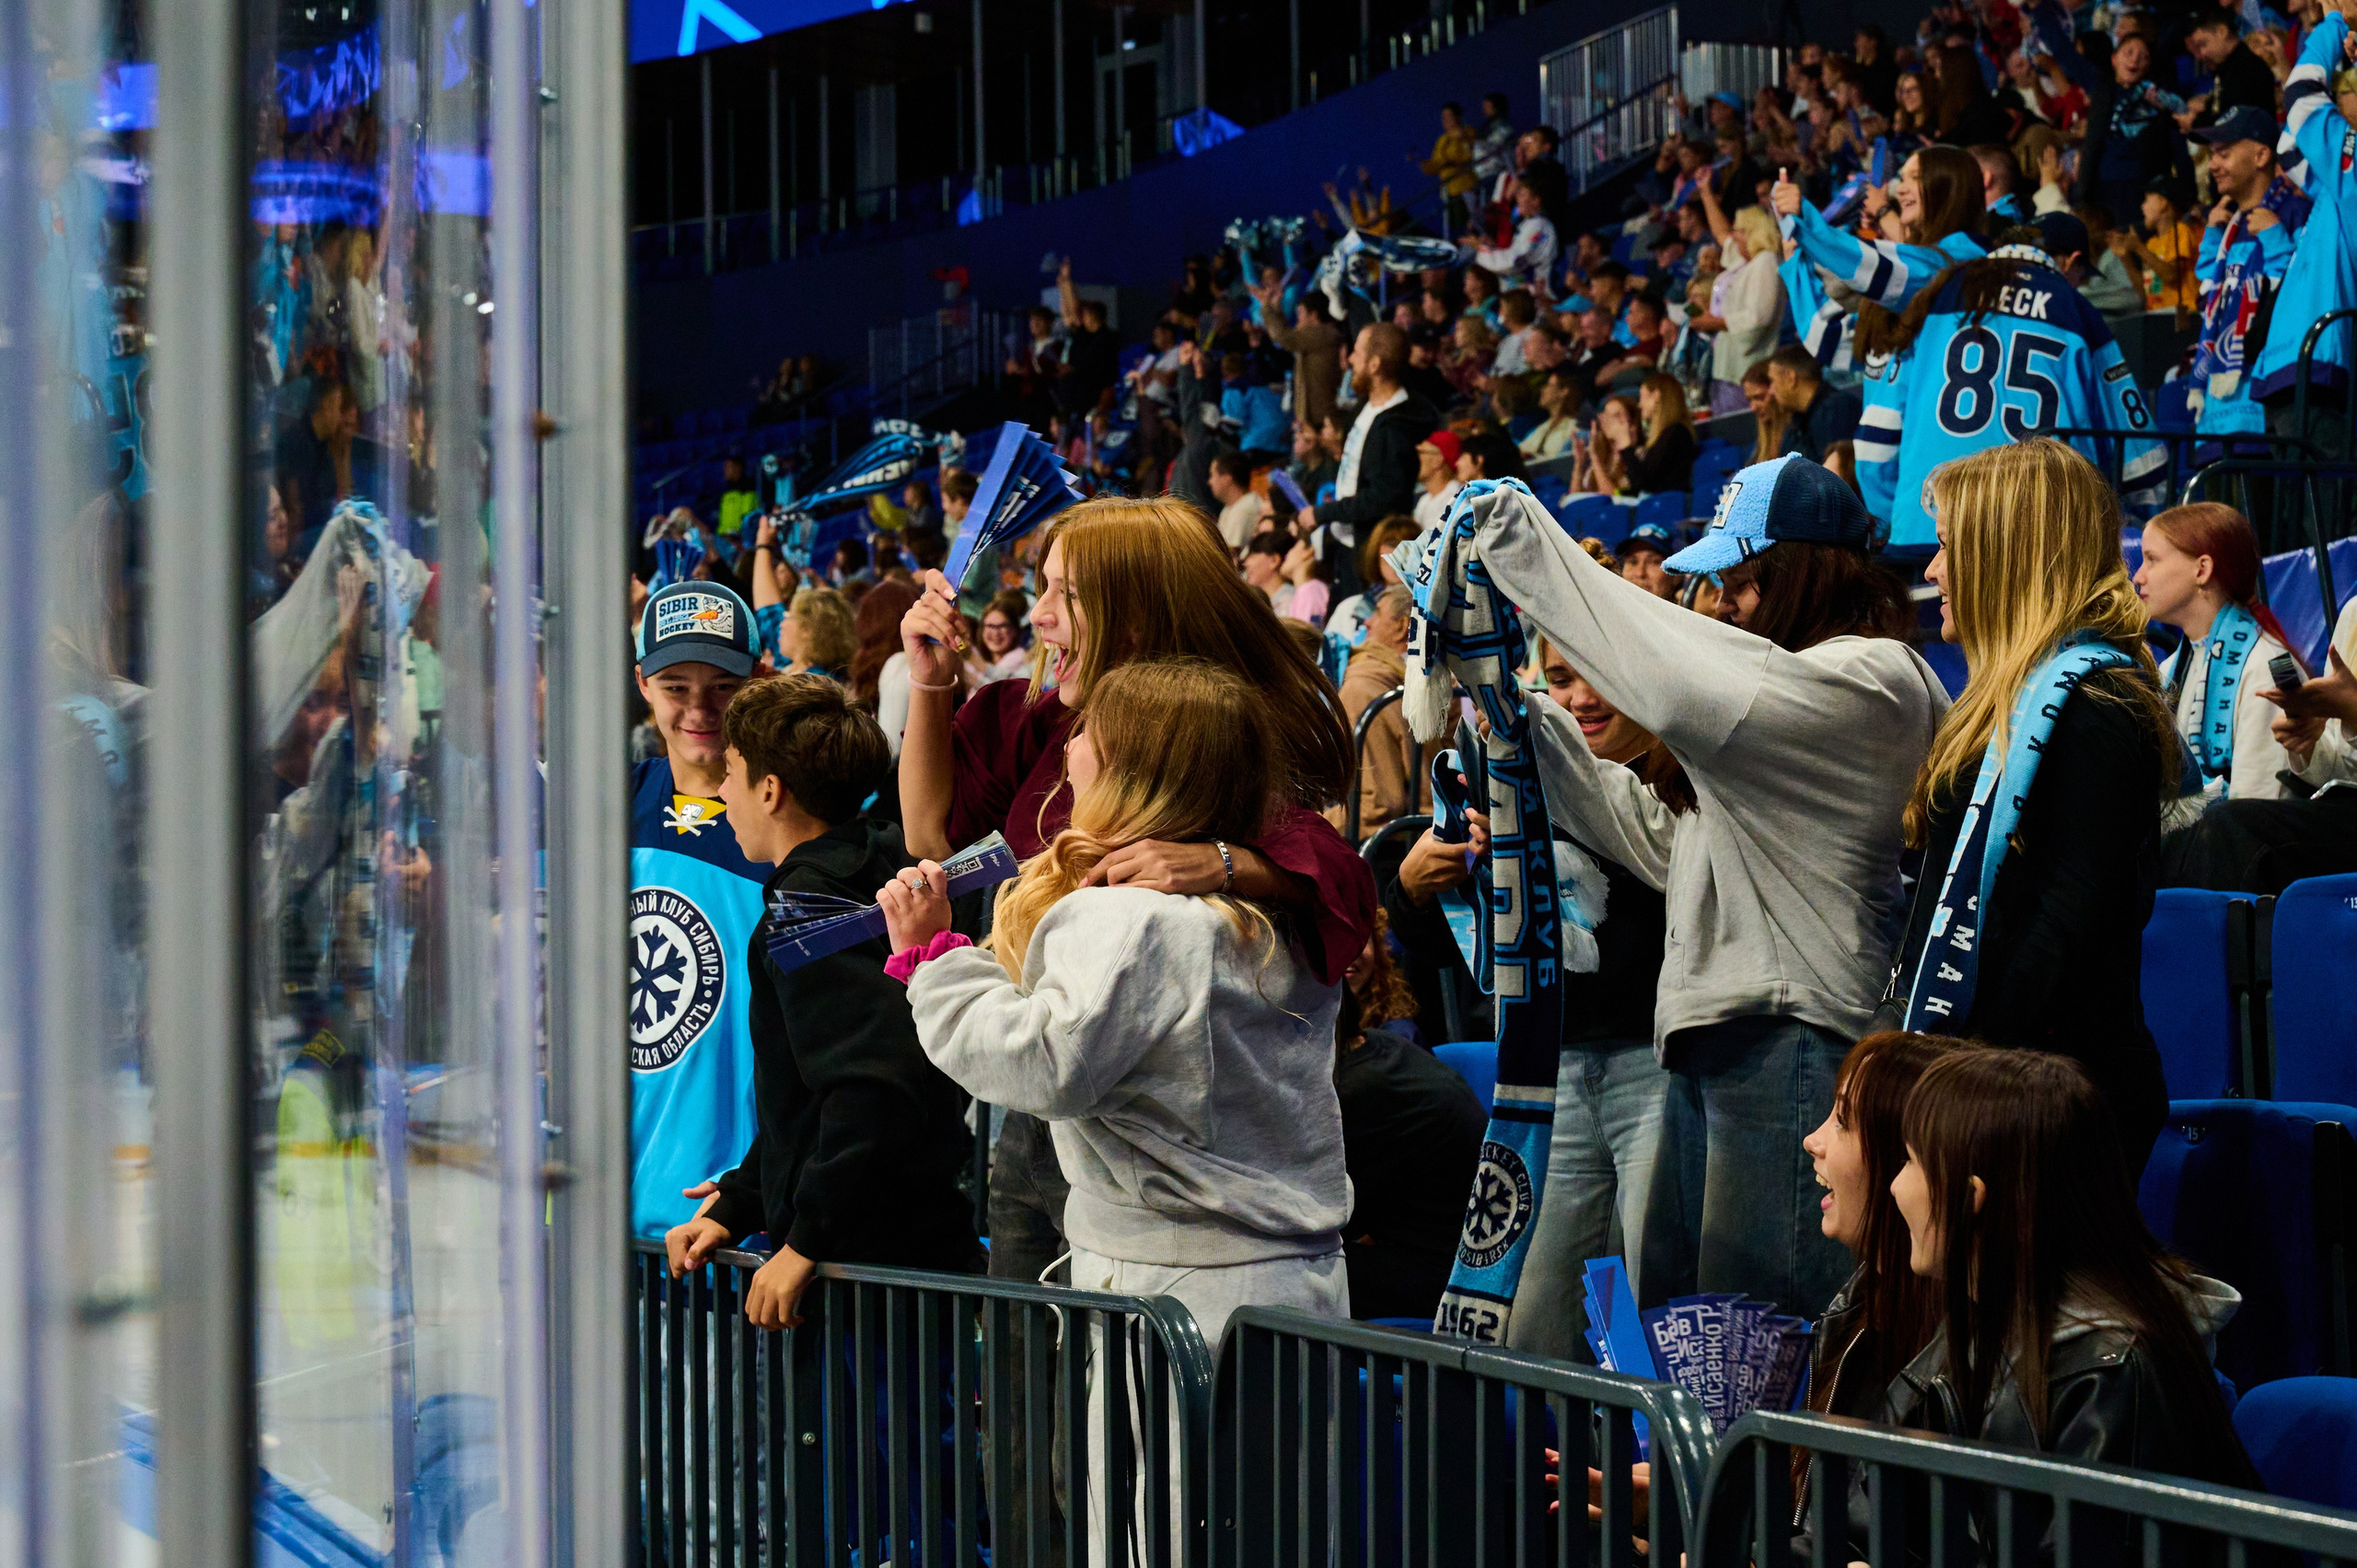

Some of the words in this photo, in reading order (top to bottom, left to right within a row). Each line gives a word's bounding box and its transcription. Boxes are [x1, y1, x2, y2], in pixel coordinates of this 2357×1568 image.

[1987, 289, 2052, 319] ECK
[1936, 326, 2067, 443] 85
[659, 597, 698, 618] SIBIR
[659, 621, 695, 637] HOCKEY
[1528, 839, 1556, 988] КЛУБ
[660, 896, 694, 924] КЛУБ
[690, 922, 720, 986] СИБИРЬ
[661, 1003, 713, 1059] ОБЛАСТЬ
[2188, 1126, 2199, 1141] 15
[1515, 1173, 1529, 1212] CLUB
[1438, 1302, 1500, 1342] 1962
[1704, 1323, 1725, 1408] Исаенко
